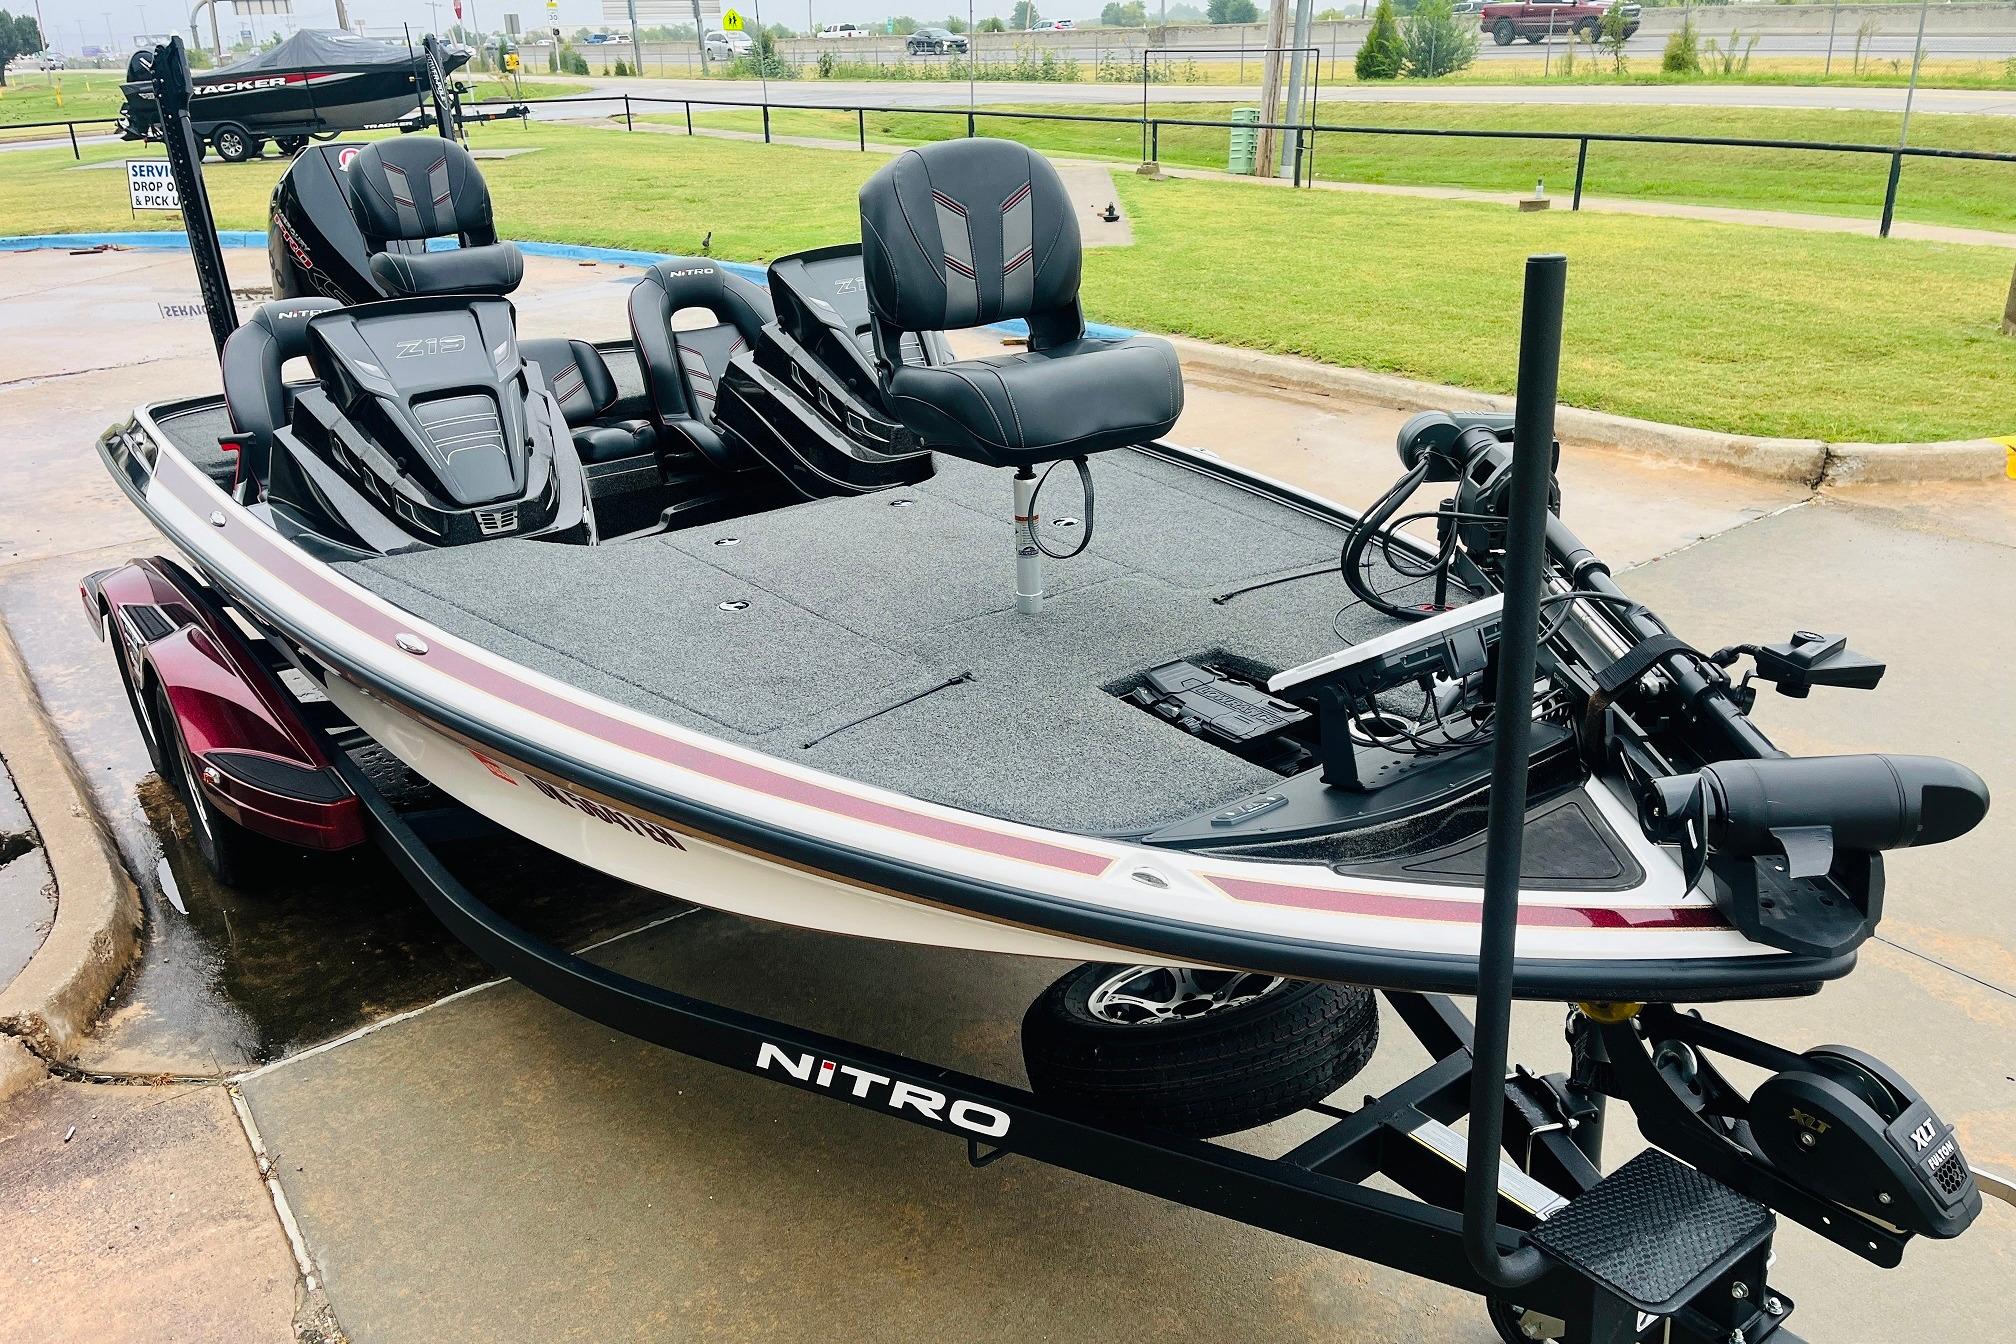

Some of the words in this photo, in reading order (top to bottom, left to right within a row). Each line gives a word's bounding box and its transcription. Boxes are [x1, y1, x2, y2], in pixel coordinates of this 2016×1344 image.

[193, 77, 286, 95] RACKER
[363, 121, 414, 129] TRACKER
[131, 165, 172, 177] SERVI
[133, 182, 163, 192] DROP
[166, 182, 175, 192] O
[135, 195, 142, 206] &
[144, 196, 169, 206] PICK
[172, 196, 180, 206] U
[834, 276, 866, 295] Z1
[278, 309, 328, 320] NITR
[395, 334, 466, 360] Z19
[1788, 1107, 1832, 1135] XLT
[1909, 1116, 1938, 1153] XLT
[1926, 1139, 1955, 1172] FULTON
